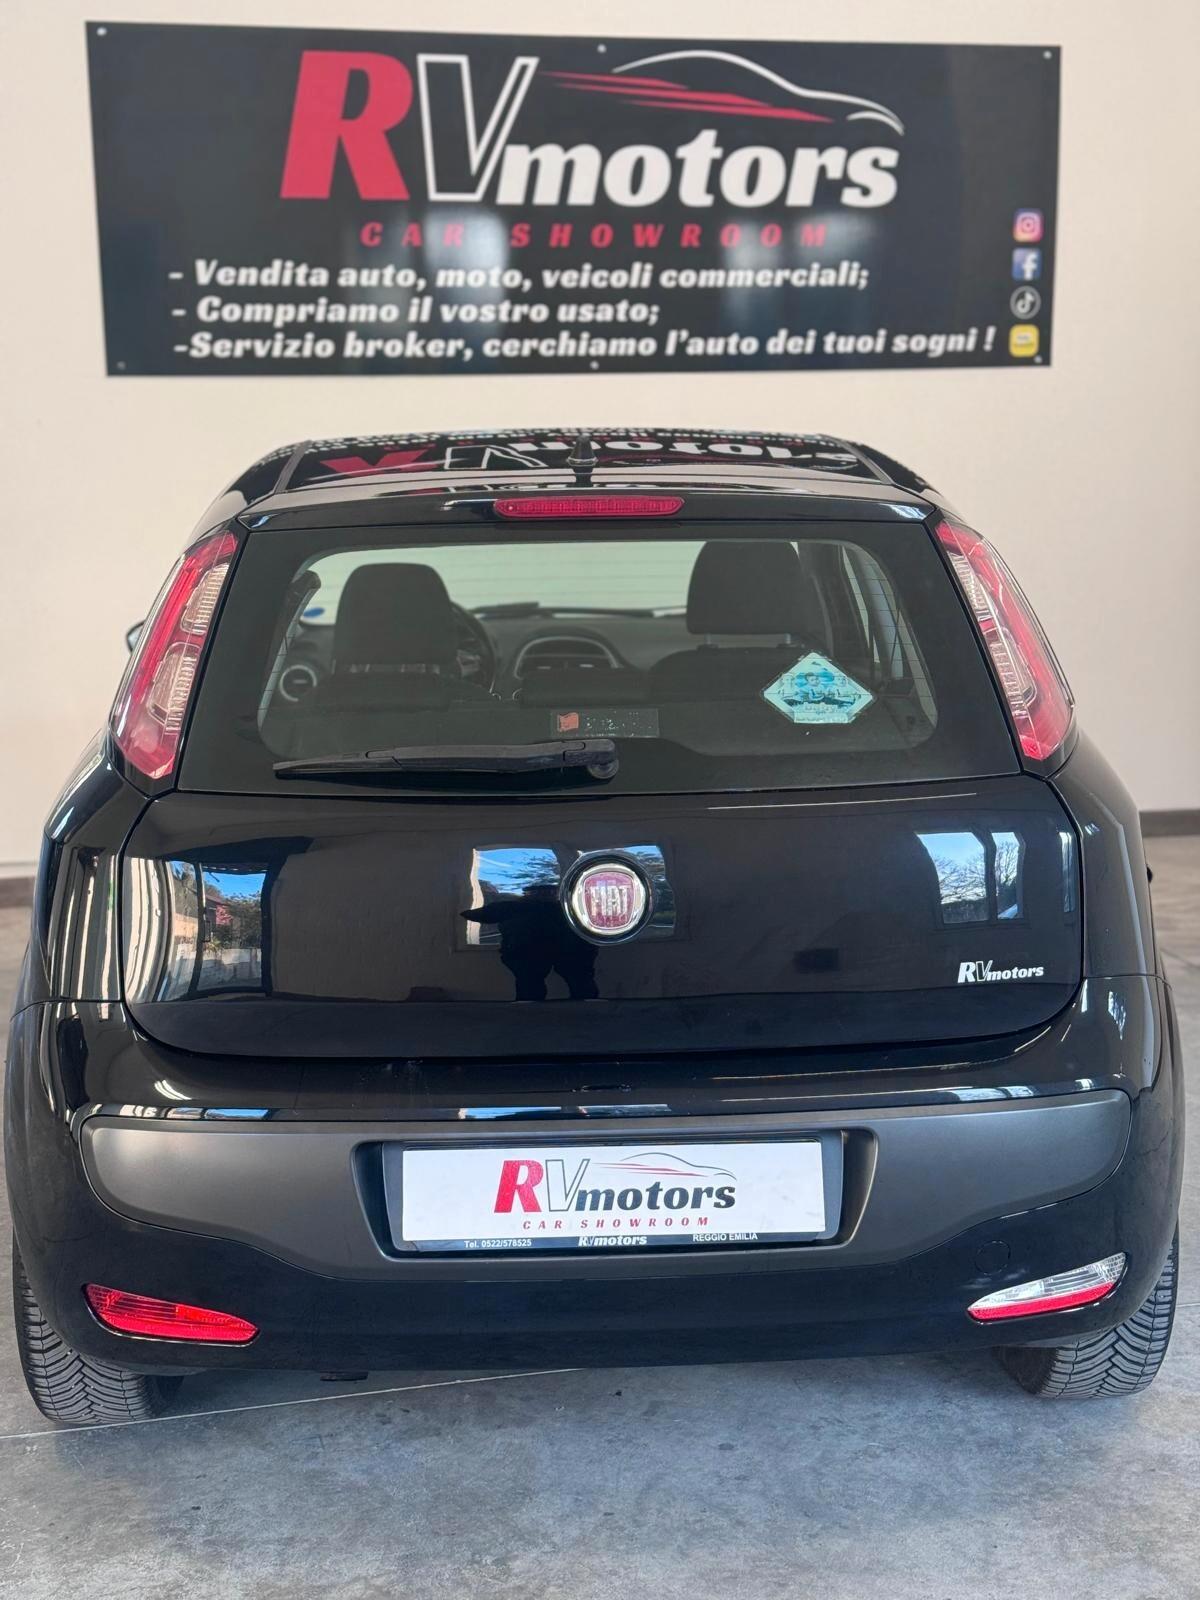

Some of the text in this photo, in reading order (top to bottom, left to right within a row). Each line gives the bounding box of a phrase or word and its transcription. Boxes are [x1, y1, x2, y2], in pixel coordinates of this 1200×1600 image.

[280, 50, 899, 207] RVmotors
[360, 222, 827, 249] CAR SHOWROOM
[195, 259, 329, 287] Vendita
[337, 264, 427, 291] auto,
[436, 264, 532, 292] moto,
[542, 262, 653, 288] veicoli
[660, 260, 869, 290] commerciali;
[197, 296, 399, 328] Compriamo
[408, 296, 433, 323] il
[439, 298, 550, 323] vostro
[557, 299, 660, 326] usato;
[343, 331, 474, 361] broker,
[482, 330, 657, 358] cerchiamo
[766, 328, 817, 355] dei
[823, 328, 887, 354] tuoi
[892, 327, 979, 358] sogni
[589, 885, 628, 917] FIAT
[957, 959, 1044, 984] RVmotors
[494, 1158, 736, 1213] RVmotors
[523, 1217, 709, 1230] CAR SHOWROOM
[692, 1232, 758, 1242] REGGIO EMILIA
[464, 1240, 479, 1249] Tel.
